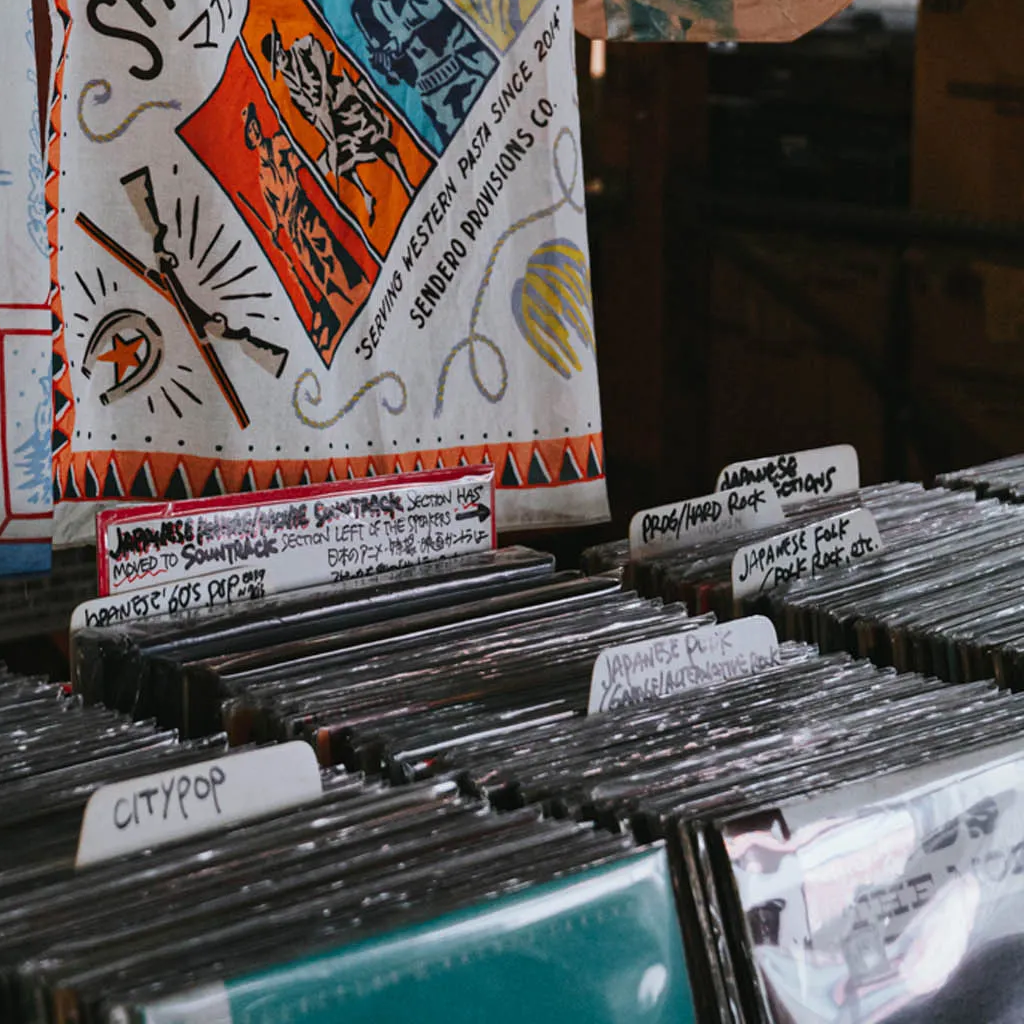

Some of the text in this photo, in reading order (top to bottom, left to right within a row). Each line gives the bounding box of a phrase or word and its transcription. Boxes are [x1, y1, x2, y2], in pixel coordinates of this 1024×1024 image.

[402, 178, 459, 272] WESTERN
[458, 121, 493, 180] PASTA
[490, 59, 535, 125] SINCE
[409, 97, 559, 329] SENDERO PROVISIONS CO.
[108, 517, 195, 560] JAPANESE
[406, 490, 453, 512] SECTION
[456, 484, 485, 504] HAS
[727, 488, 768, 516] ROCK
[112, 555, 159, 580] MOVED
[160, 552, 179, 570] TO
[280, 529, 332, 554] SECTION
[334, 524, 365, 545] LEFT
[369, 520, 382, 537] OF
[384, 517, 406, 537] THE
[407, 510, 452, 536] SPEAKERS
[739, 517, 851, 583] JAPANESE FOLK
[601, 636, 681, 690] JAPANESE
